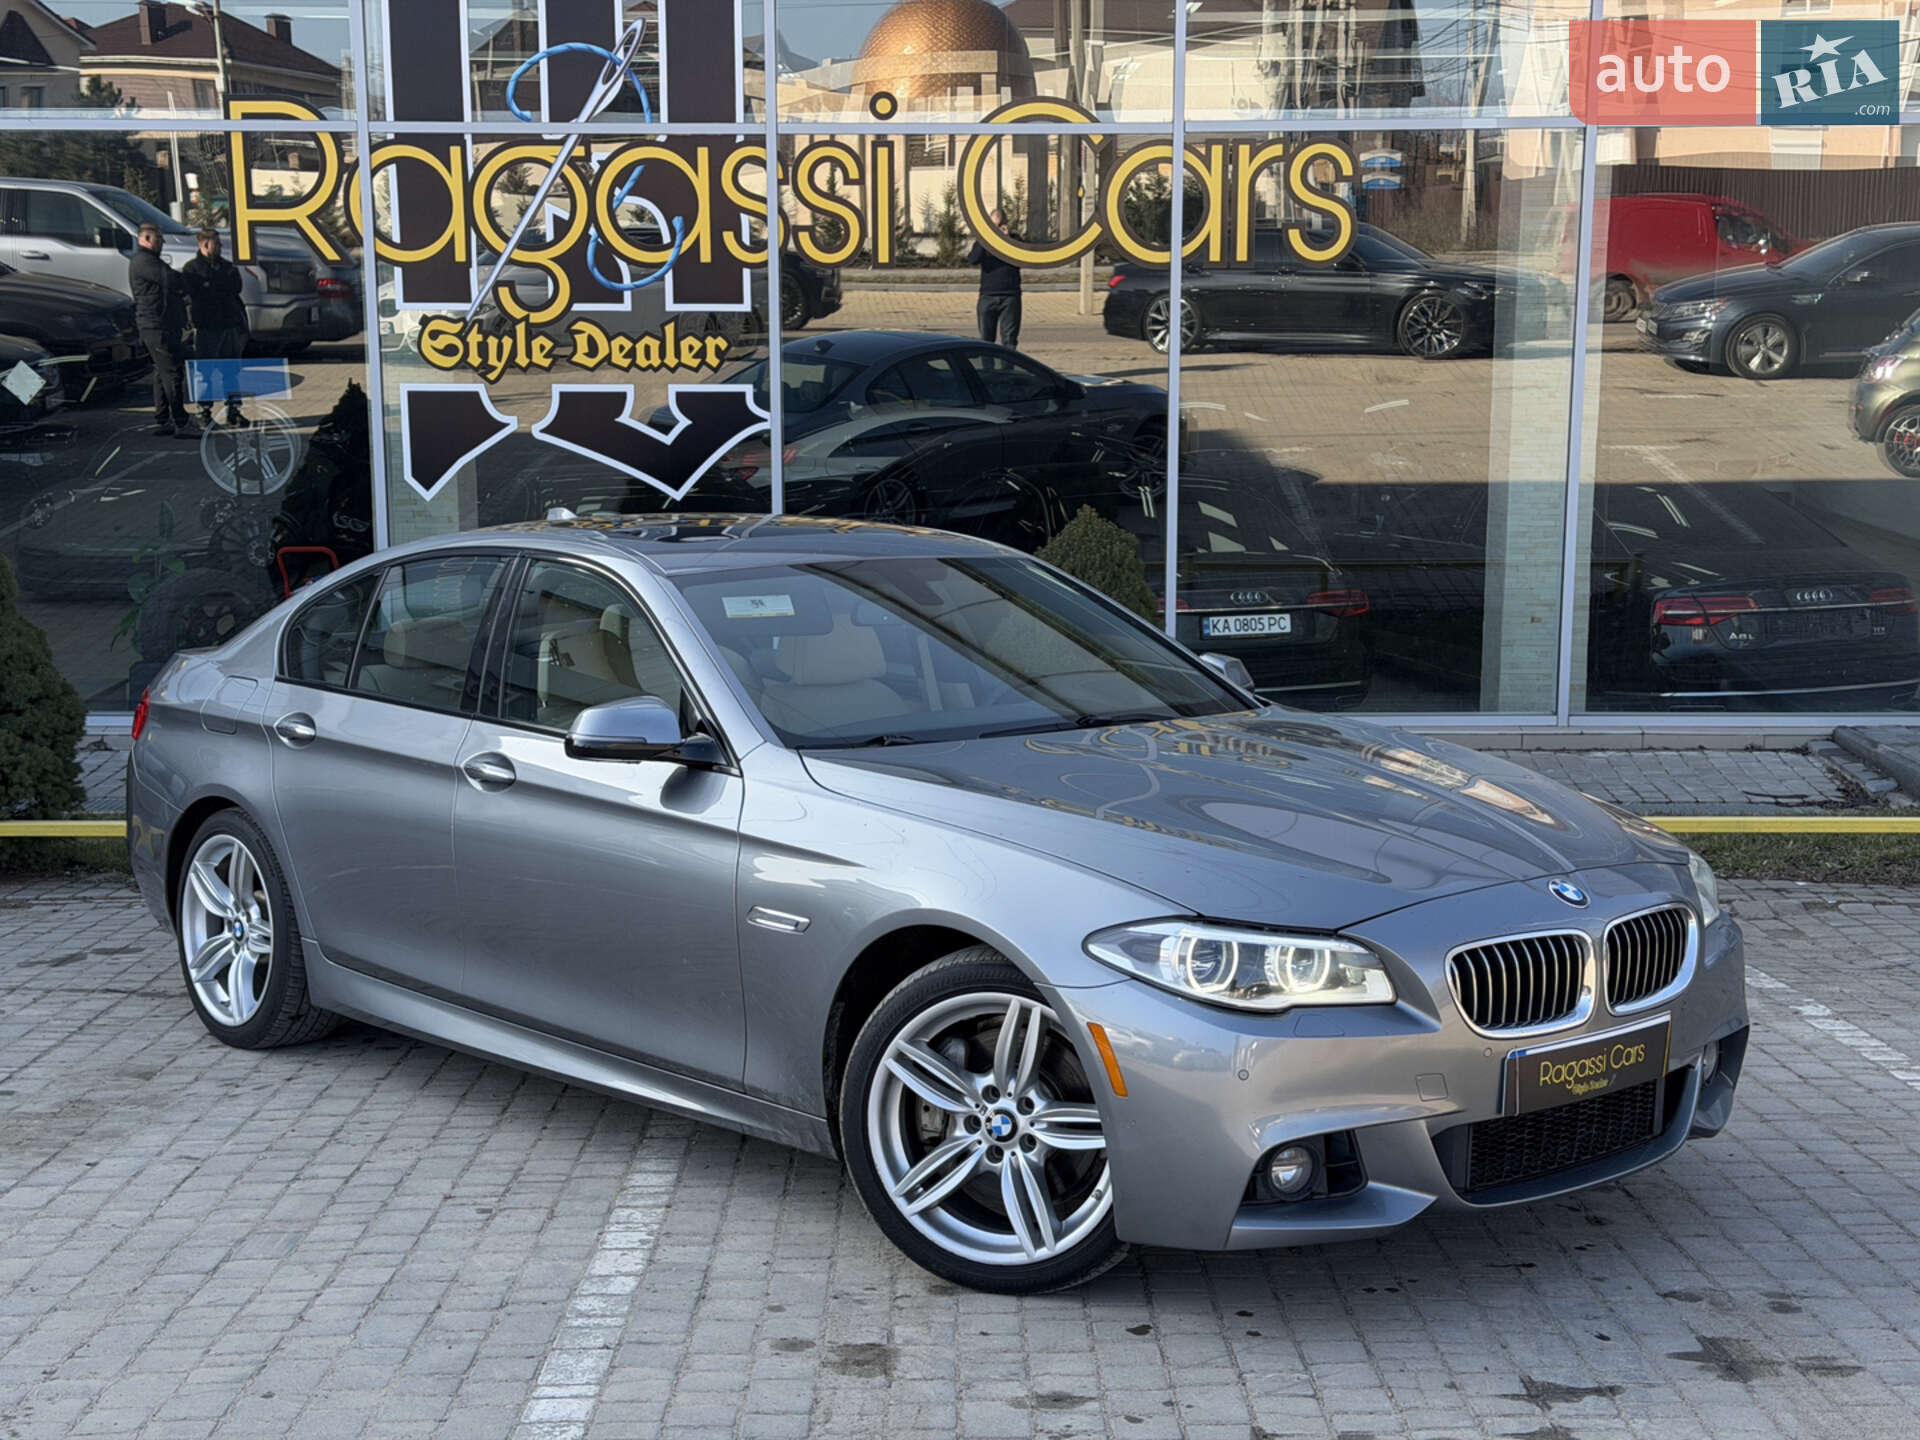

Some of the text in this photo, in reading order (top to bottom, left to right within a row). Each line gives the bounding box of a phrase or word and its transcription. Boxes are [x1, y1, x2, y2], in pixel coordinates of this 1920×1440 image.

[227, 92, 1357, 323] Ragassi Cars
[418, 314, 731, 384] Style Dealer
[1211, 616, 1288, 633] KA 0805 PC
[1539, 1047, 1608, 1089] Ragassi
[1610, 1043, 1646, 1070] Cars
